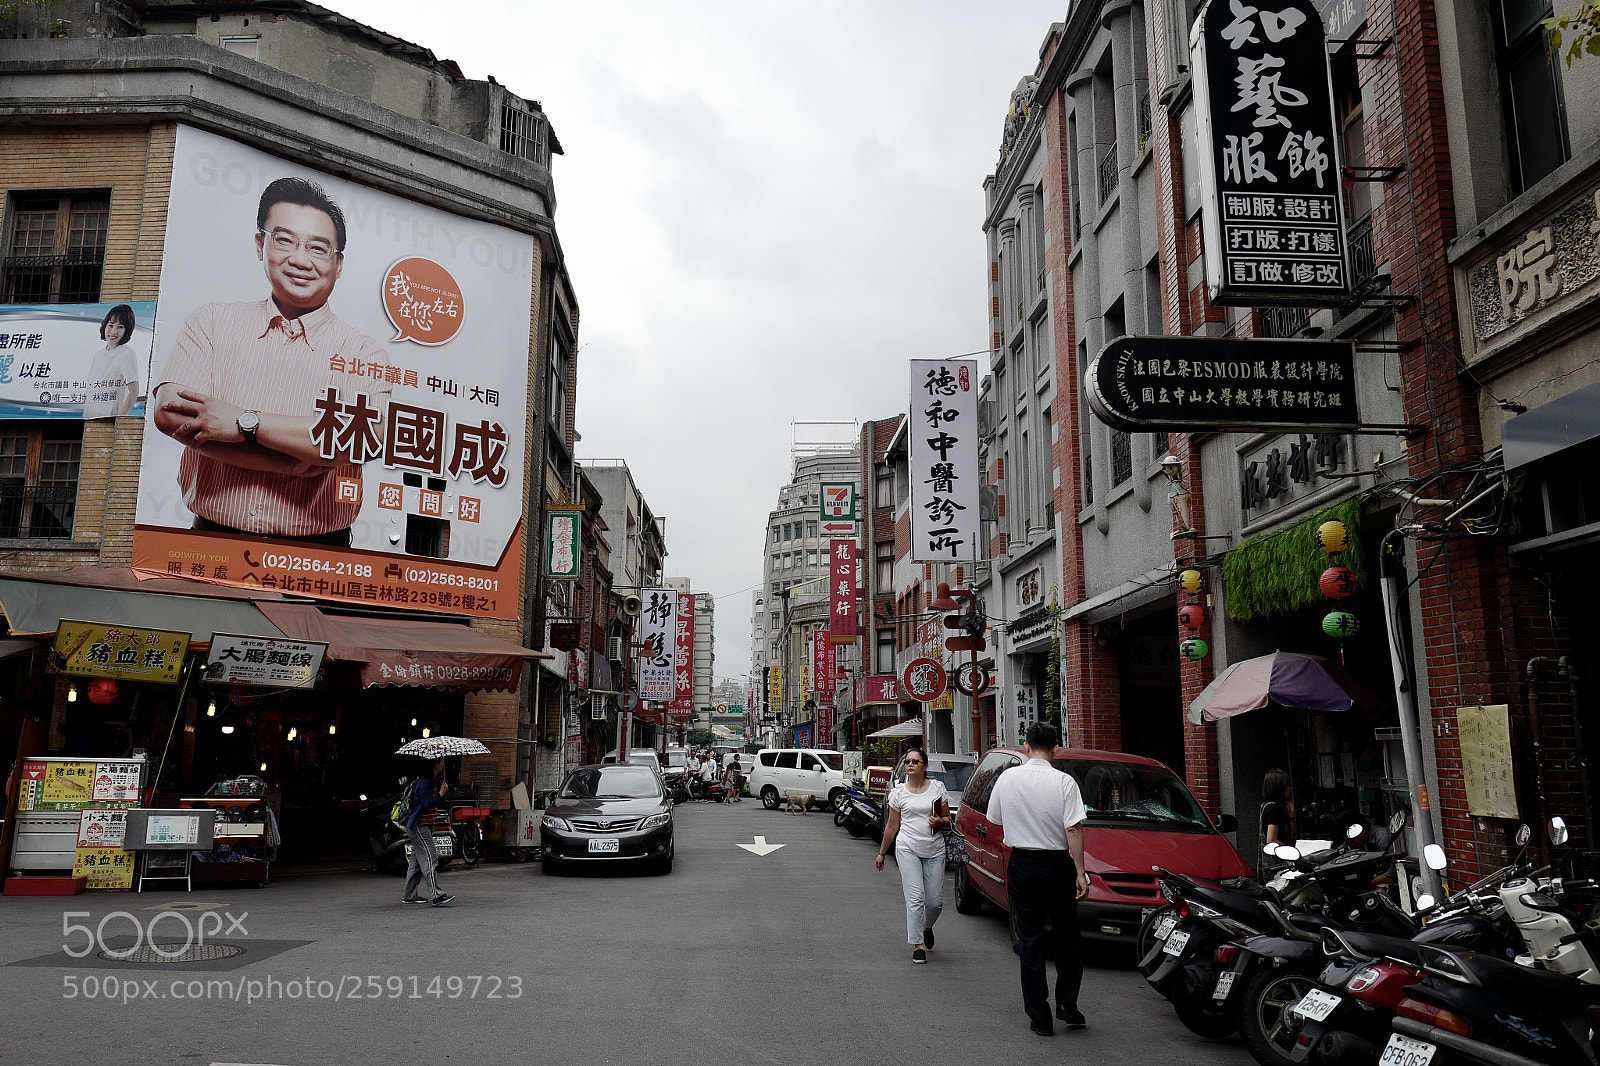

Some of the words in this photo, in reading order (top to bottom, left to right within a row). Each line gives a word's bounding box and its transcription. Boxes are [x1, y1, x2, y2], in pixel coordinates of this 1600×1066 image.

[1223, 130, 1329, 189] 服飾
[1227, 196, 1332, 219] 制服·設計
[1230, 229, 1335, 251] 打版·打樣
[1233, 261, 1339, 284] 訂做·修改
[18, 362, 52, 379] 以赴
[330, 353, 419, 389] 台北市議員
[426, 375, 458, 398] 中山
[469, 385, 500, 407] 大同
[310, 387, 508, 487] 林國成
[923, 366, 967, 558] 德和中醫診所
[336, 478, 480, 522] 向您問好
[167, 561, 228, 580] 服務處
[262, 551, 373, 578] (02)2564-2188
[261, 573, 497, 612] 台北市中山區吉林路239號2樓之1
[404, 567, 499, 592] (02)2563-8201
[86, 642, 167, 669] 豬血糕
[218, 646, 313, 667] 大腸麵線
[83, 854, 125, 866] 豬血糕
